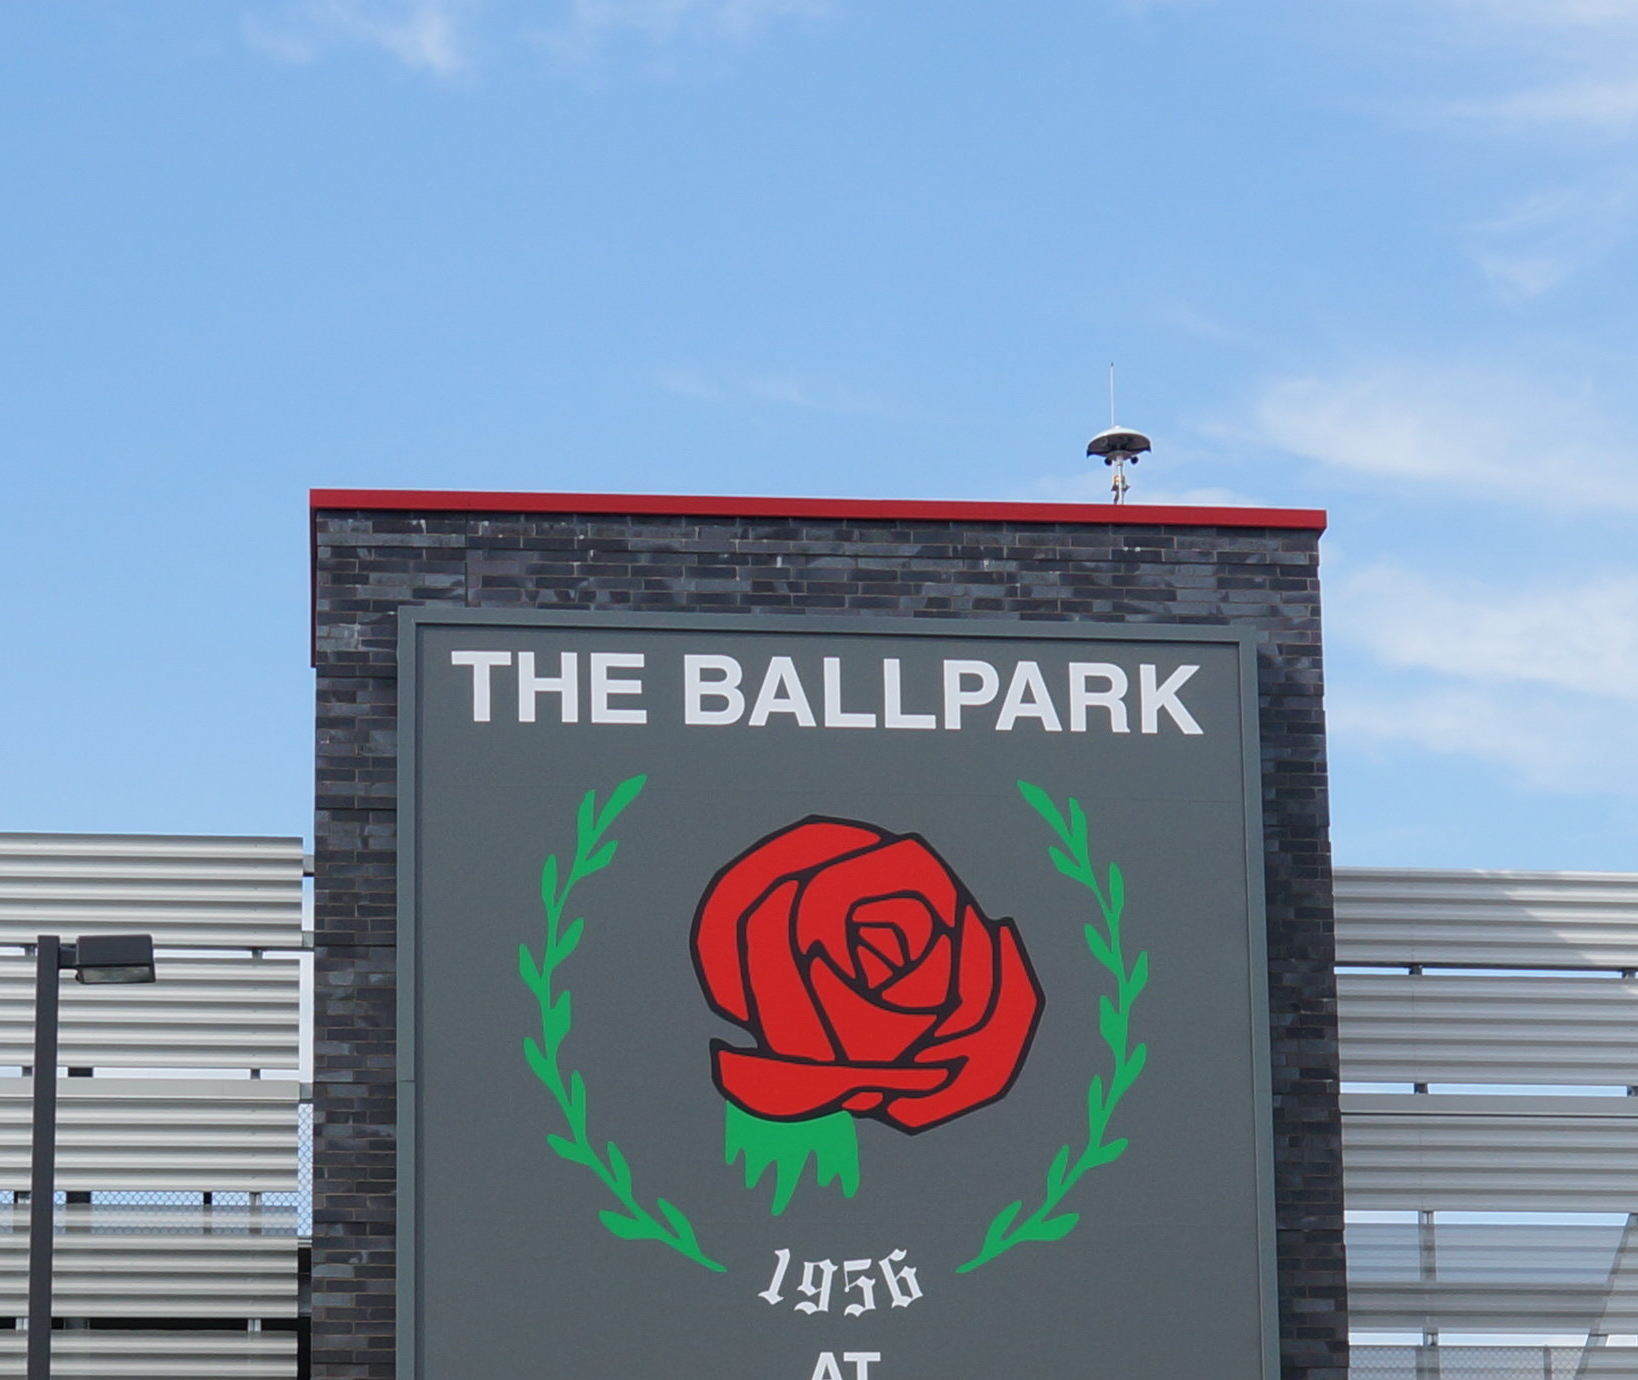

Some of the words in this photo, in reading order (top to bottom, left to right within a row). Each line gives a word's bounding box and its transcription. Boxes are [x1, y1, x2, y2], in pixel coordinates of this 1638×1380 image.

[452, 651, 648, 724] THE
[684, 655, 1204, 735] BALLPARK
[758, 1248, 923, 1317] 1956
